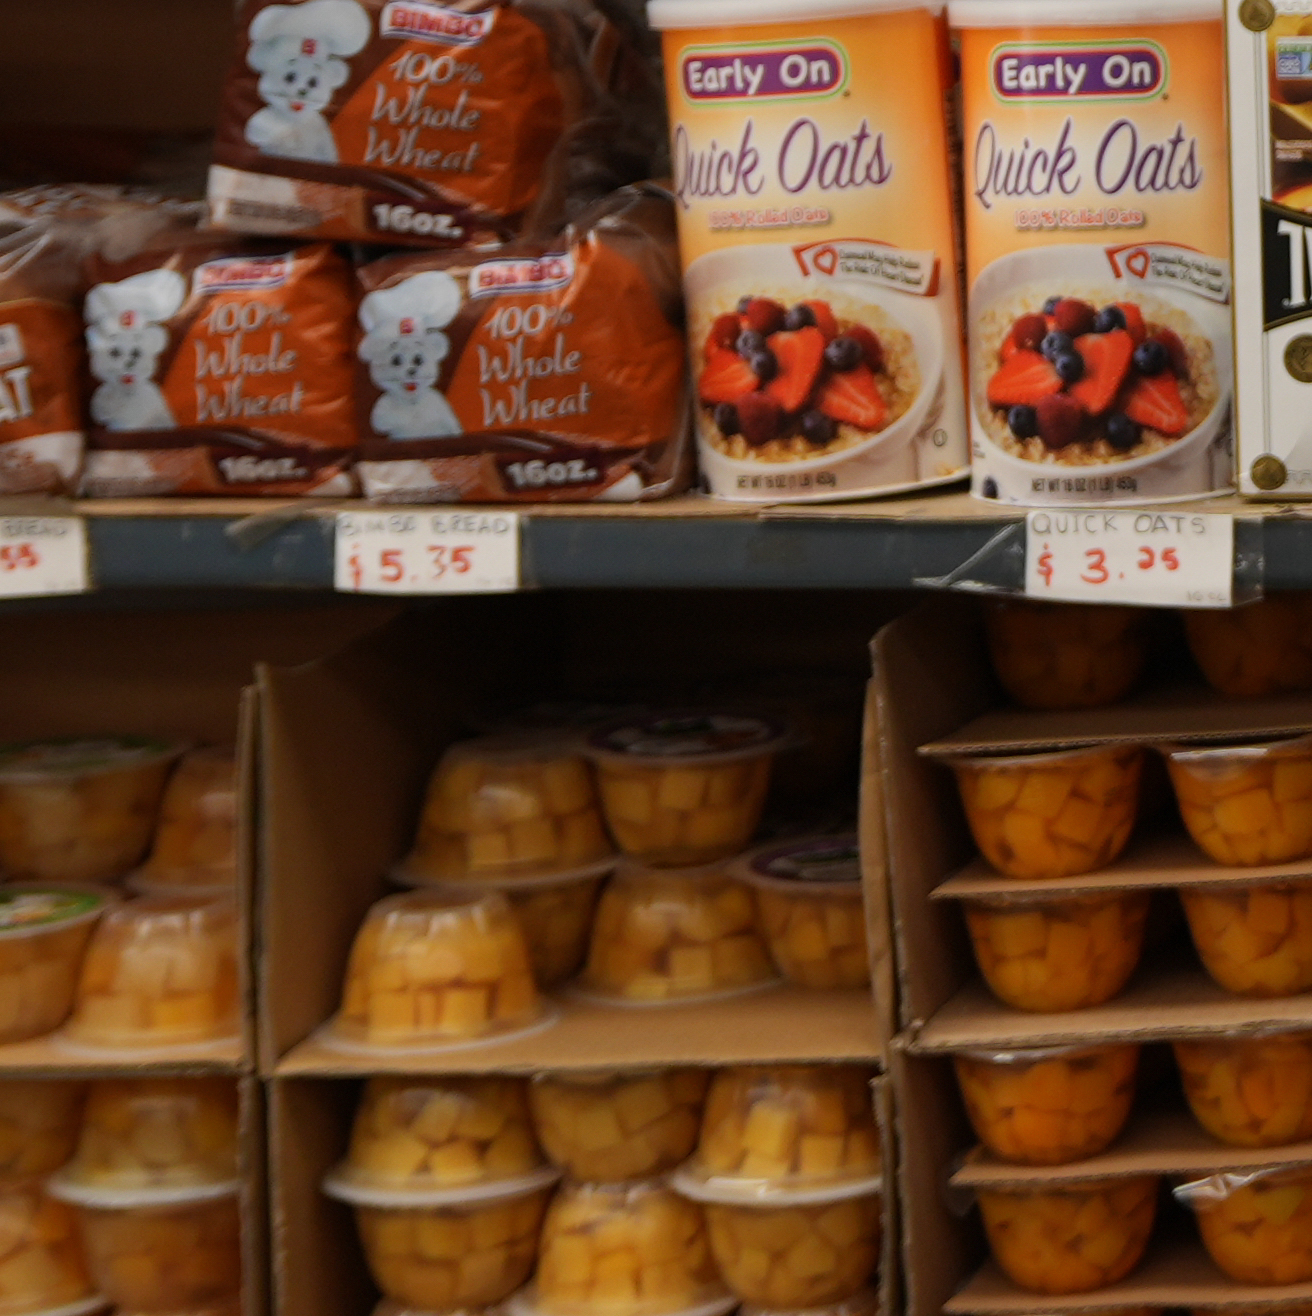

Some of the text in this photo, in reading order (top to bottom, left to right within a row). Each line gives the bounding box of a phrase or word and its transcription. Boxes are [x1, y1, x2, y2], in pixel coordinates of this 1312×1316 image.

[688, 55, 832, 95] Early On
[1000, 56, 1152, 94] Early On
[372, 87, 480, 131] Whole
[363, 129, 481, 173] Wheat
[672, 116, 893, 209] Quick Oats
[975, 117, 1202, 209] Quick Oats
[194, 334, 296, 375] Whole
[478, 338, 581, 382] Whole
[196, 376, 305, 418] Wheat
[481, 384, 591, 426] Wheat
[1032, 514, 1206, 535] QUICK OATS
[1037, 542, 1180, 585] $ 3.25
